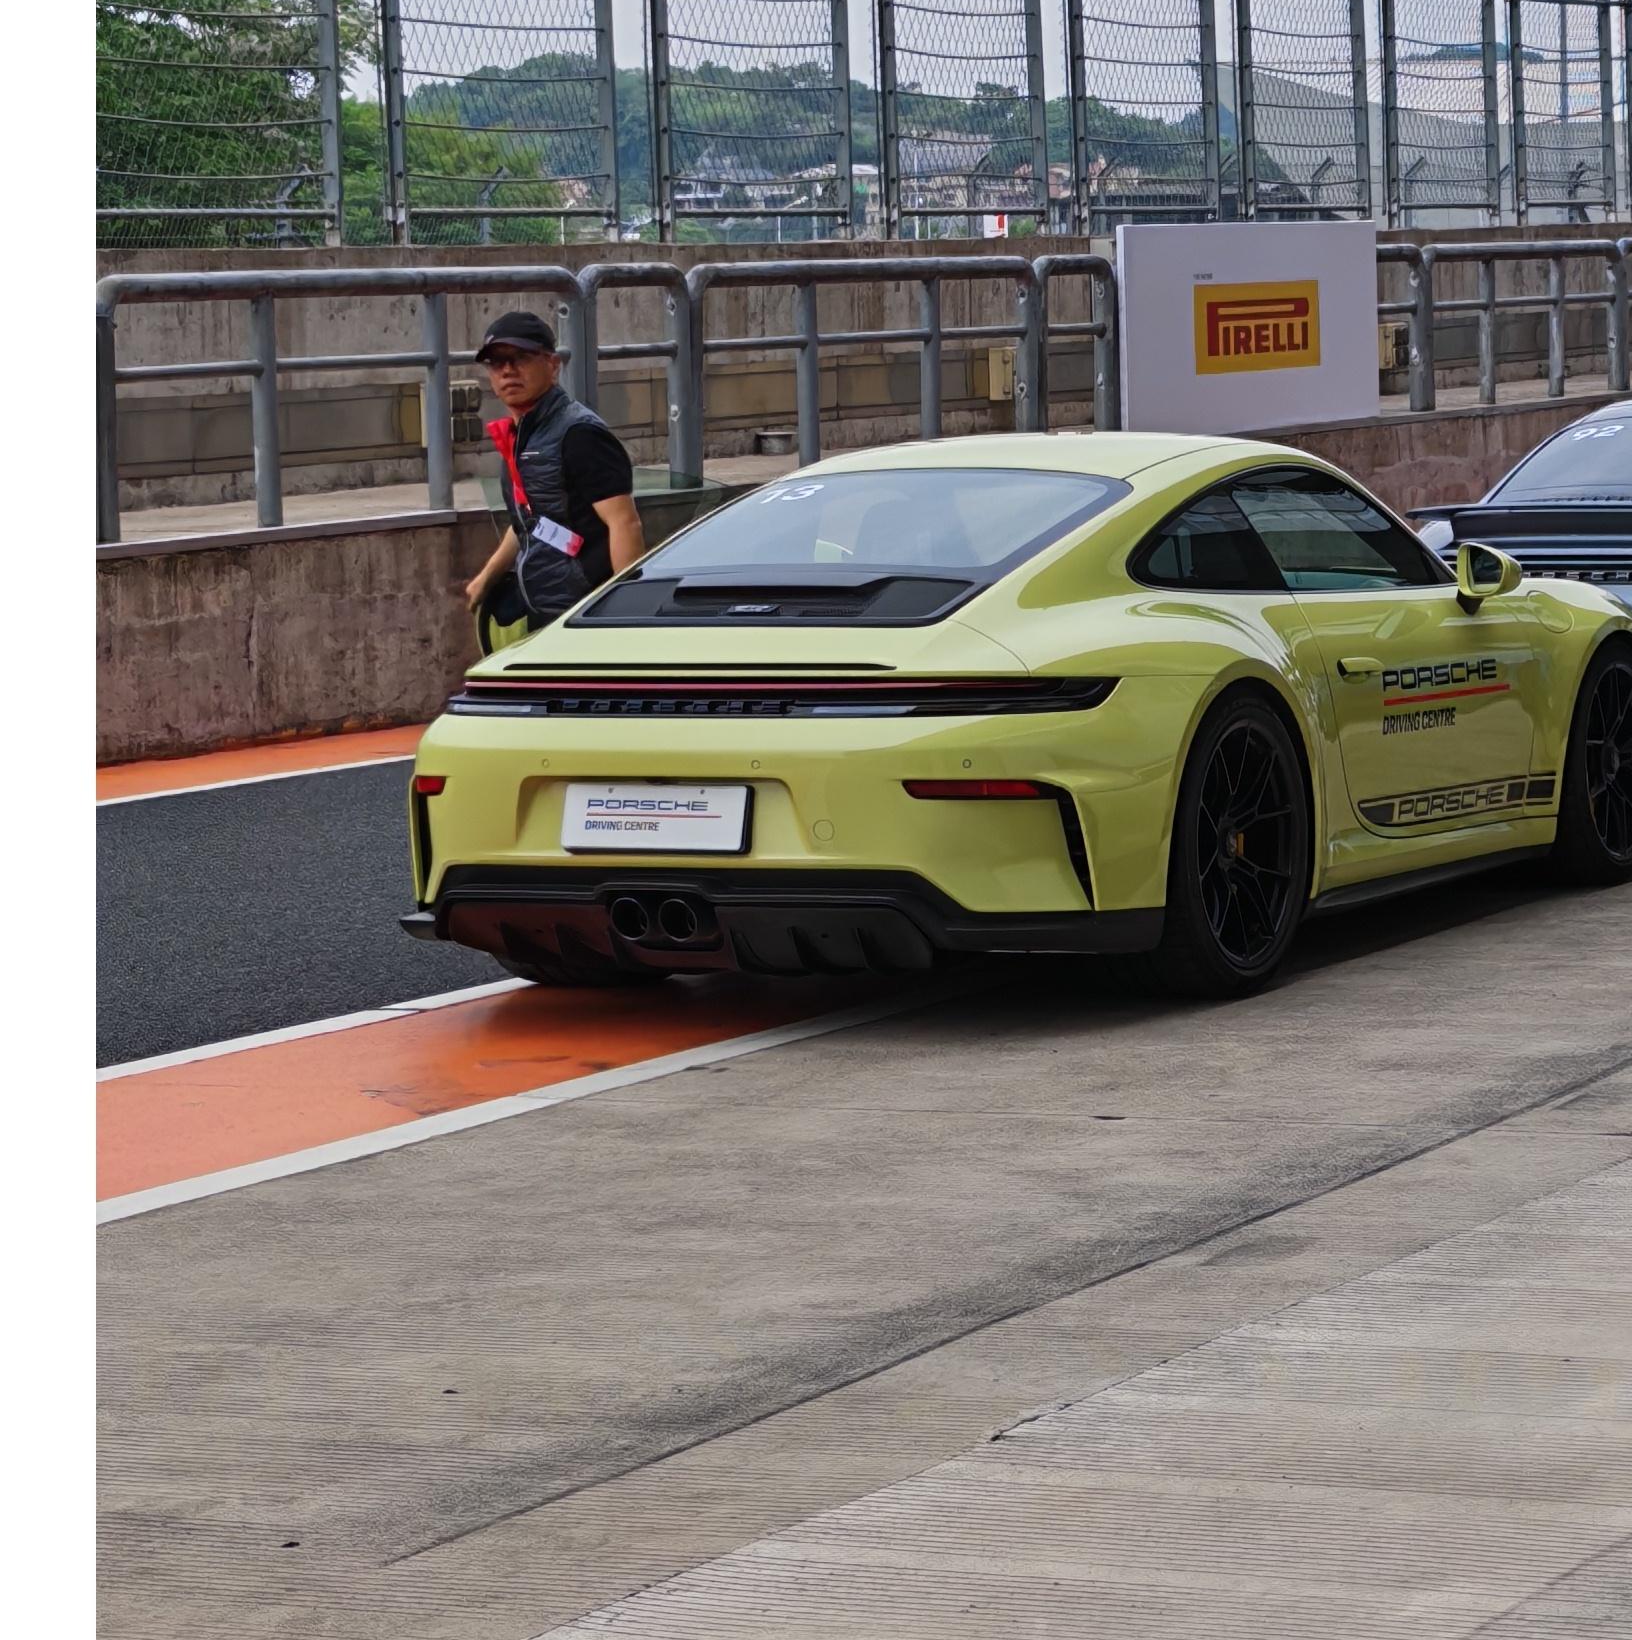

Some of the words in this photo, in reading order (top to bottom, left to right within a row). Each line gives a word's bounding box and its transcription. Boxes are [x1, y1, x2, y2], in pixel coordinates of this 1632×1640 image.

[1206, 297, 1309, 357] PIRELLI
[1572, 425, 1625, 440] 92
[760, 483, 825, 504] 13
[1383, 659, 1497, 691] PORSCHE
[1383, 710, 1420, 735] DRIVING
[1421, 707, 1456, 731] CENTRE
[587, 799, 708, 812] PORSCHE
[1398, 785, 1504, 823] PORSCHE
[585, 820, 623, 831] DRIVING
[624, 821, 660, 832] CENTRE
